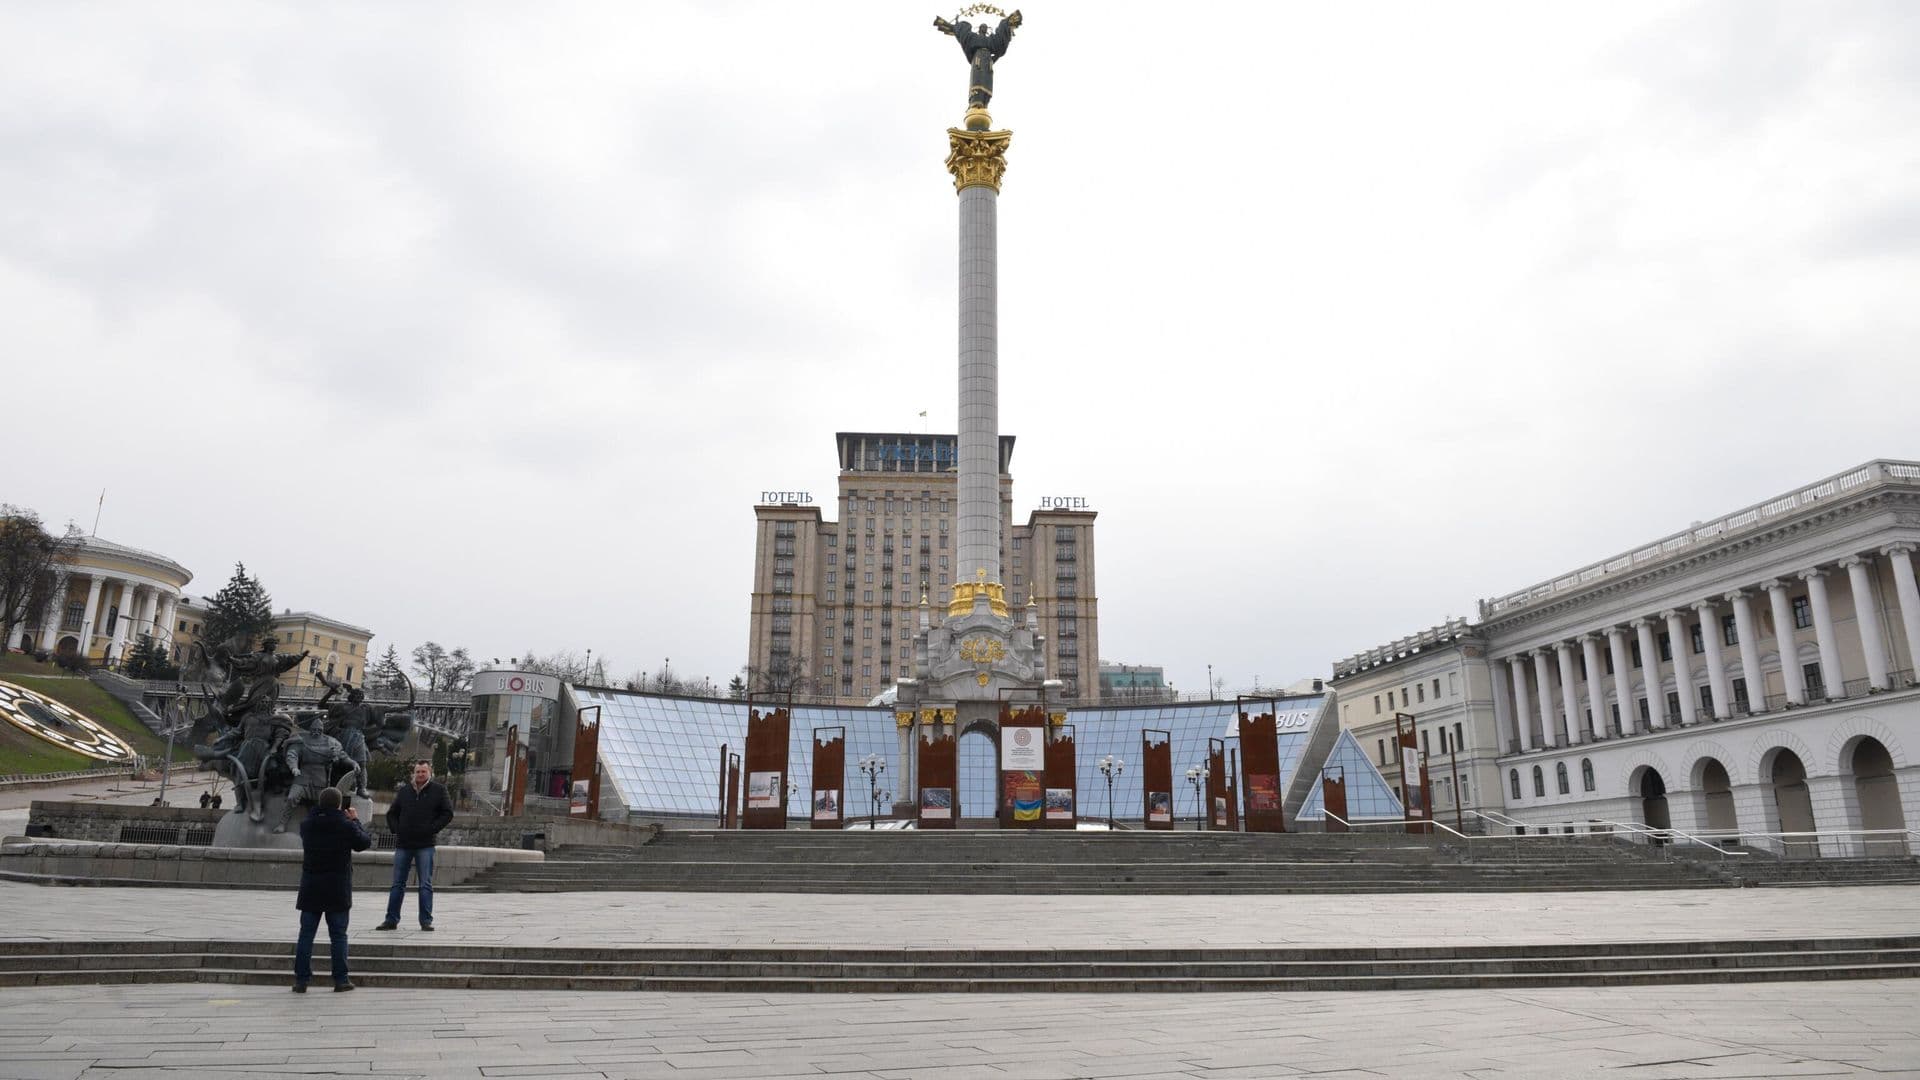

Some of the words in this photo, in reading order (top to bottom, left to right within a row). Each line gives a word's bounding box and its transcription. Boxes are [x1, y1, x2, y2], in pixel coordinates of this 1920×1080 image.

[761, 491, 813, 503] ГОТЕЛЬ
[1042, 496, 1090, 508] HOTEL
[498, 677, 545, 693] GLOBUS
